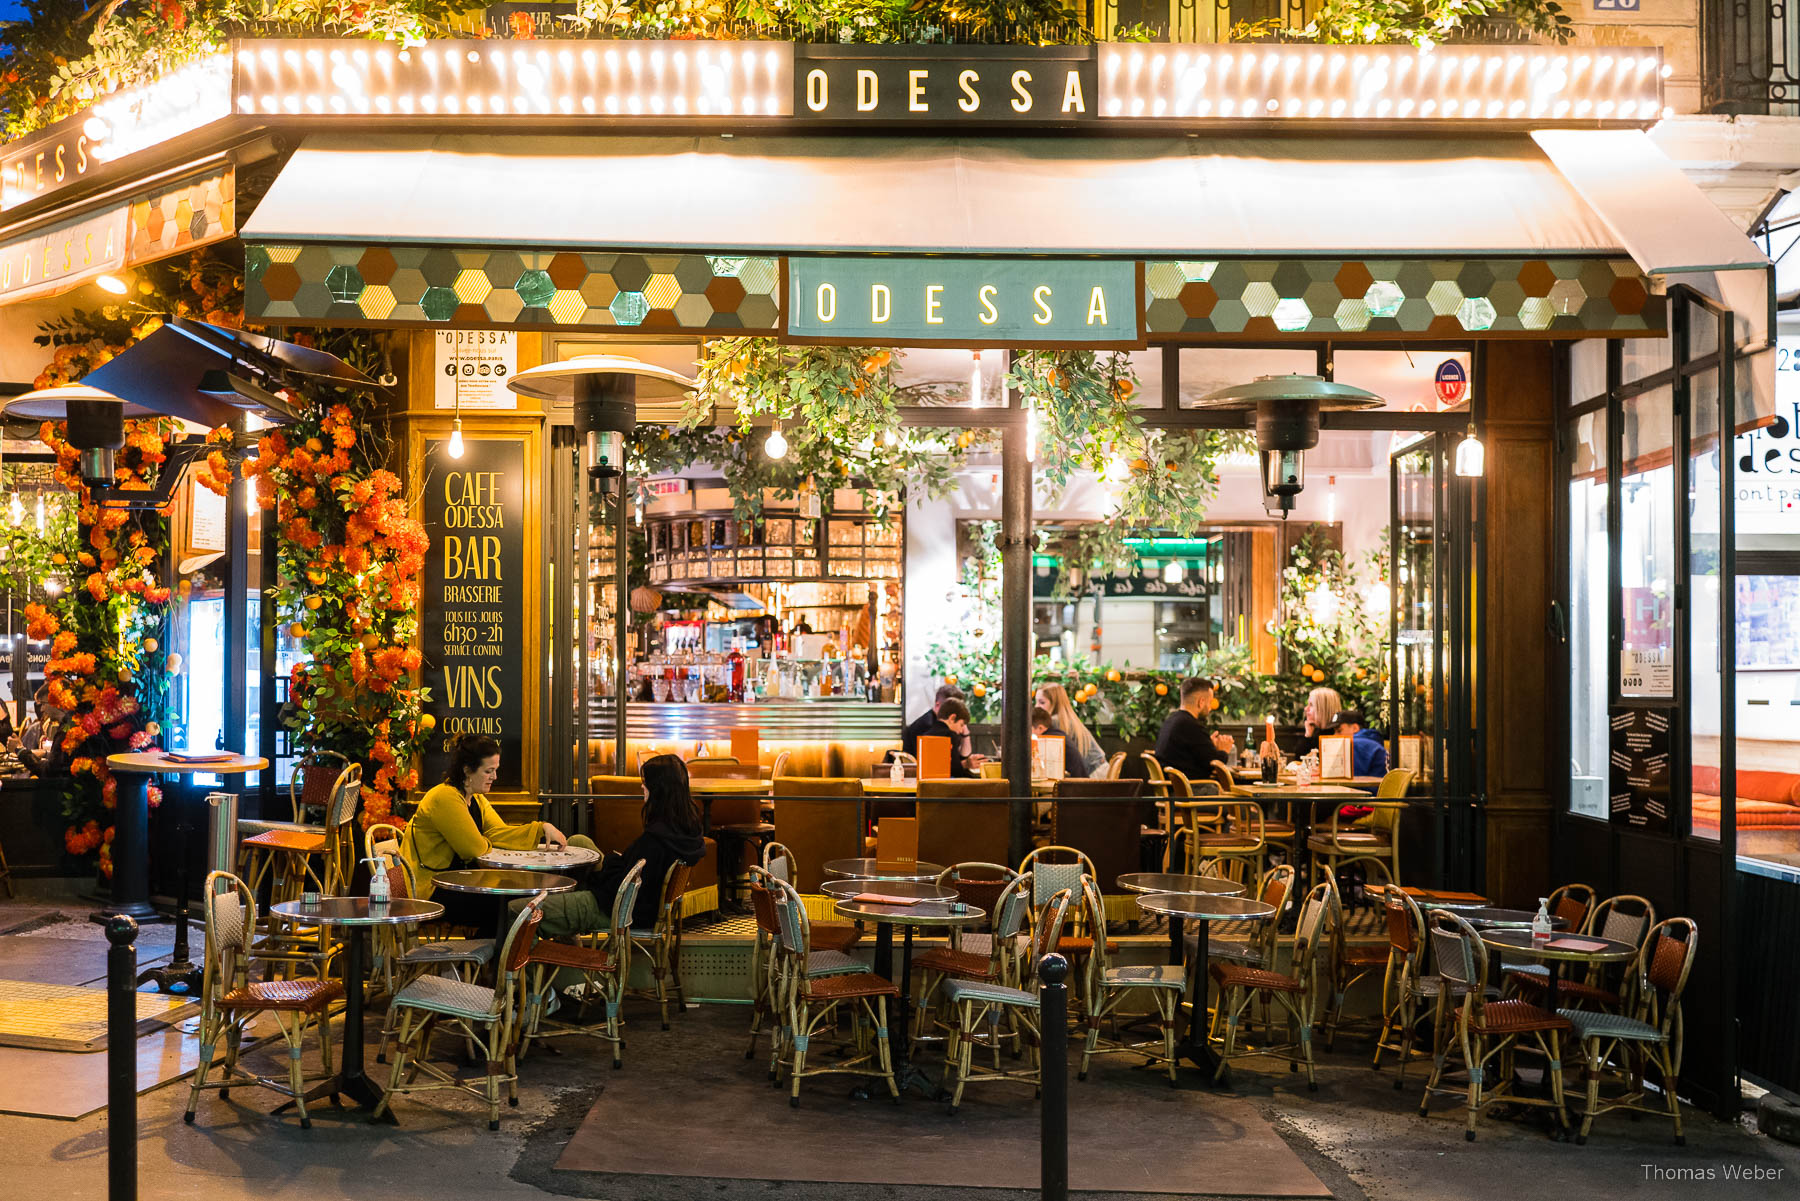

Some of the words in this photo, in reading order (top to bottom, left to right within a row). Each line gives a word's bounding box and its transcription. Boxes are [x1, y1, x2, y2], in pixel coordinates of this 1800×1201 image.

[806, 69, 1086, 113] ODESSA
[2, 226, 114, 289] ODESSA
[816, 282, 1109, 325] ODESSA
[444, 505, 504, 529] ODESSA
[444, 535, 503, 580] BAR
[443, 585, 503, 603] BRASSERIE
[445, 611, 463, 623] TOUS
[464, 611, 477, 623] LES
[478, 611, 503, 623] JOURS
[1635, 597, 1660, 621] H
[443, 623, 478, 645] 6h30
[443, 644, 471, 656] SERVICE
[472, 644, 503, 656] CONTINU
[443, 665, 503, 709] VINS
[443, 717, 502, 734] COCKTAILS
